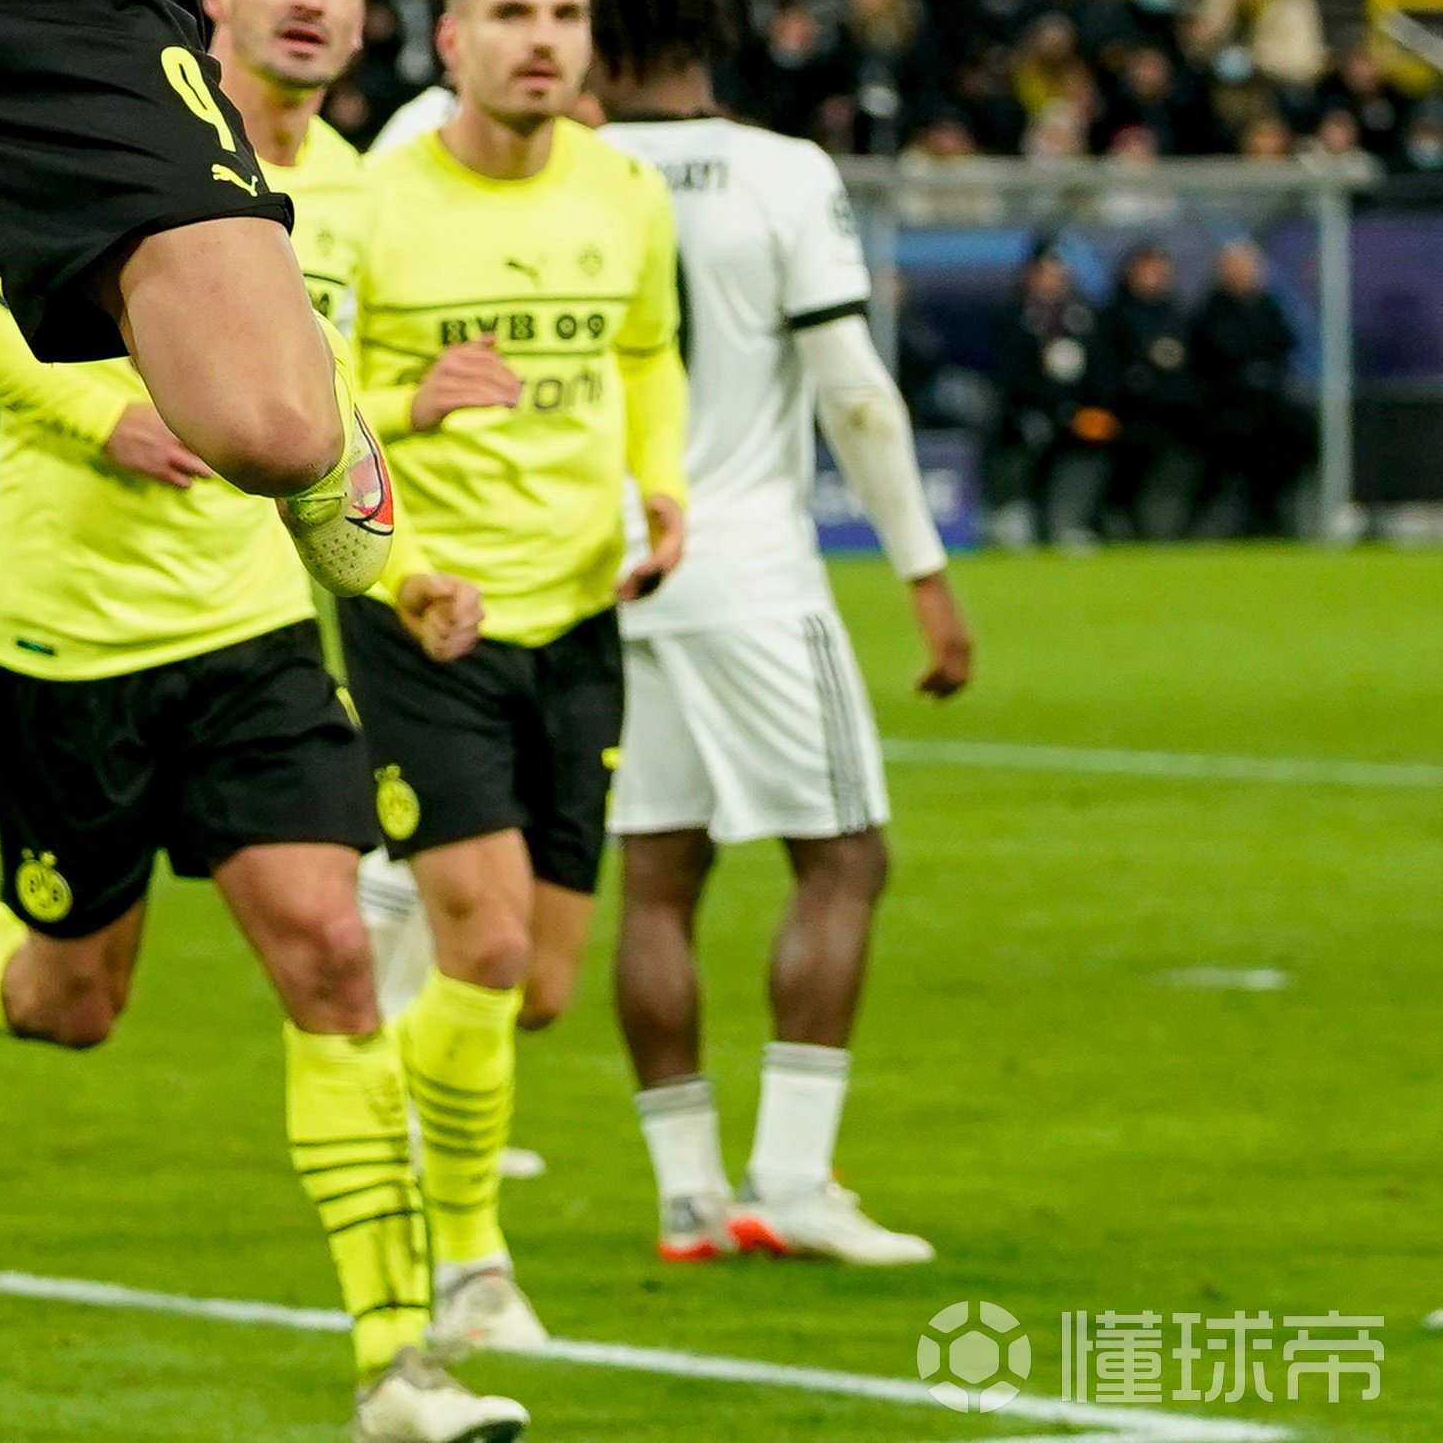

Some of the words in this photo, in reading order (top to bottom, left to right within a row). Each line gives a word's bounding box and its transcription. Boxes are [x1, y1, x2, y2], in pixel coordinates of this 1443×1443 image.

[161, 46, 236, 153] 9
[441, 314, 534, 345] BVB
[556, 314, 605, 340] 09
